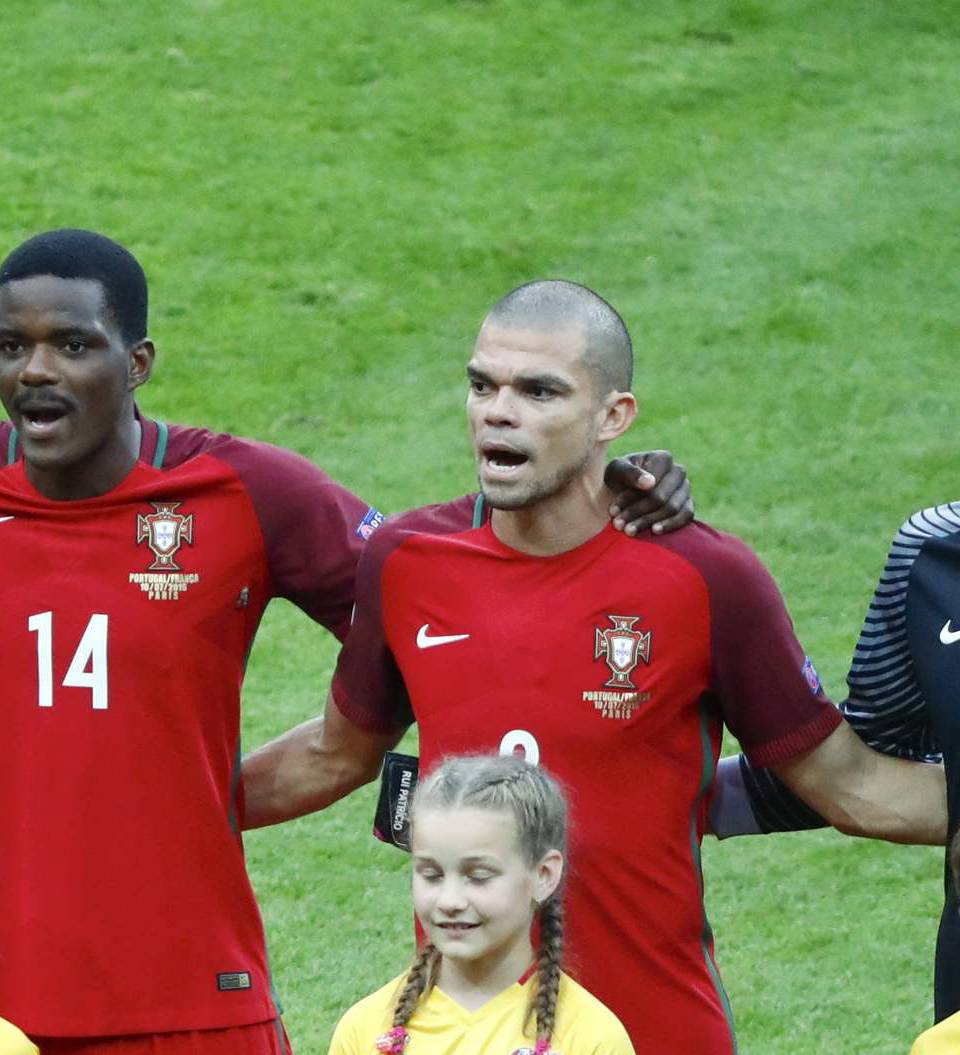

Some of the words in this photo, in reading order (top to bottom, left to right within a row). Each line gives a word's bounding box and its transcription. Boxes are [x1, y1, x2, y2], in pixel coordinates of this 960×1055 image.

[148, 591, 179, 600] PARIS
[28, 611, 108, 709] 14
[400, 770, 413, 788] RUI
